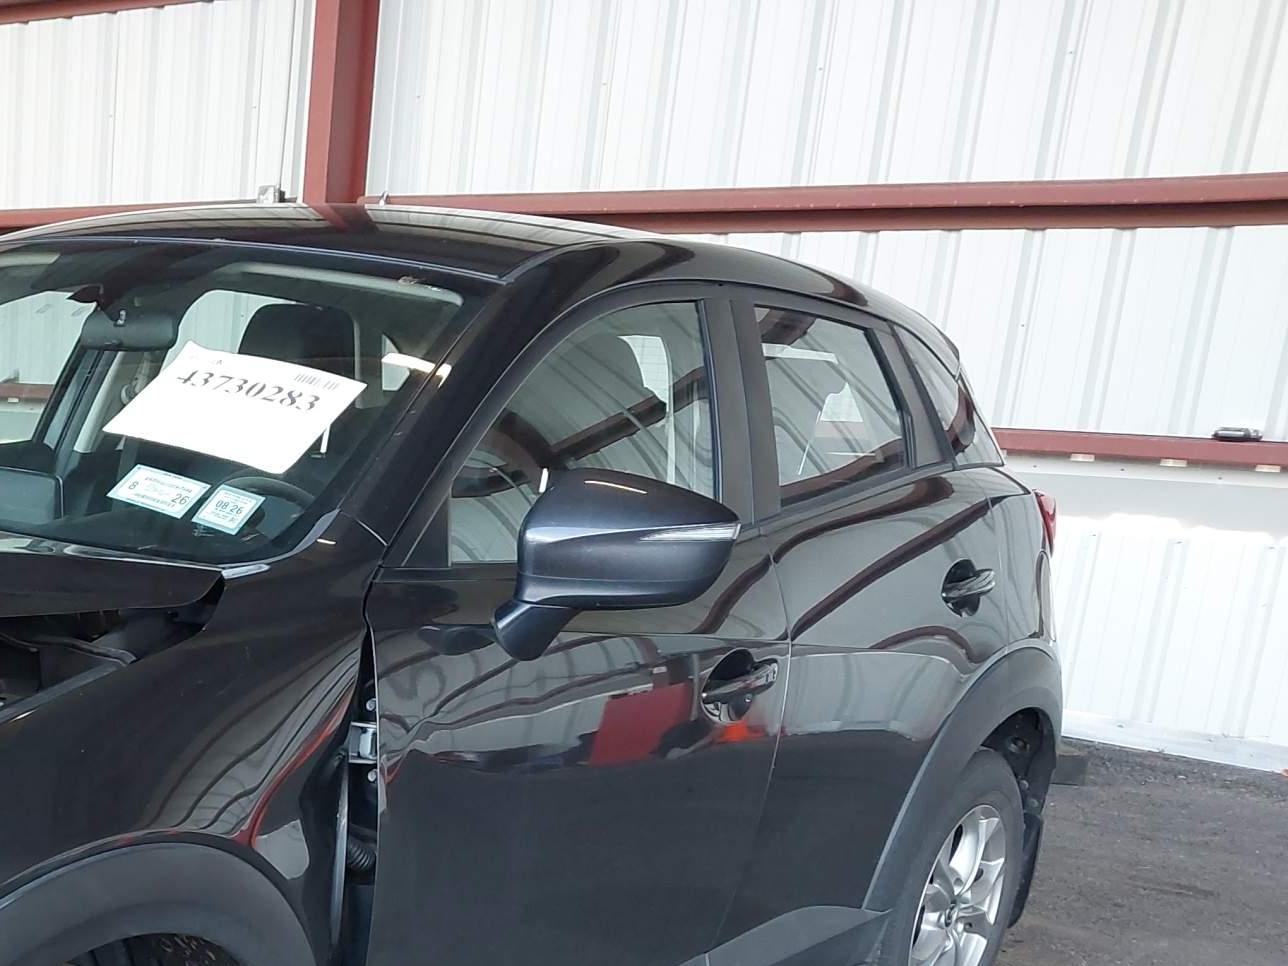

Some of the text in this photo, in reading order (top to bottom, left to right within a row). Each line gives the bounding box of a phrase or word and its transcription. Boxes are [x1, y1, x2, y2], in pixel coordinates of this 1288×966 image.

[177, 370, 321, 411] 43730283
[171, 493, 191, 506] 26
[215, 499, 229, 510] 08
[229, 503, 243, 516] 26
